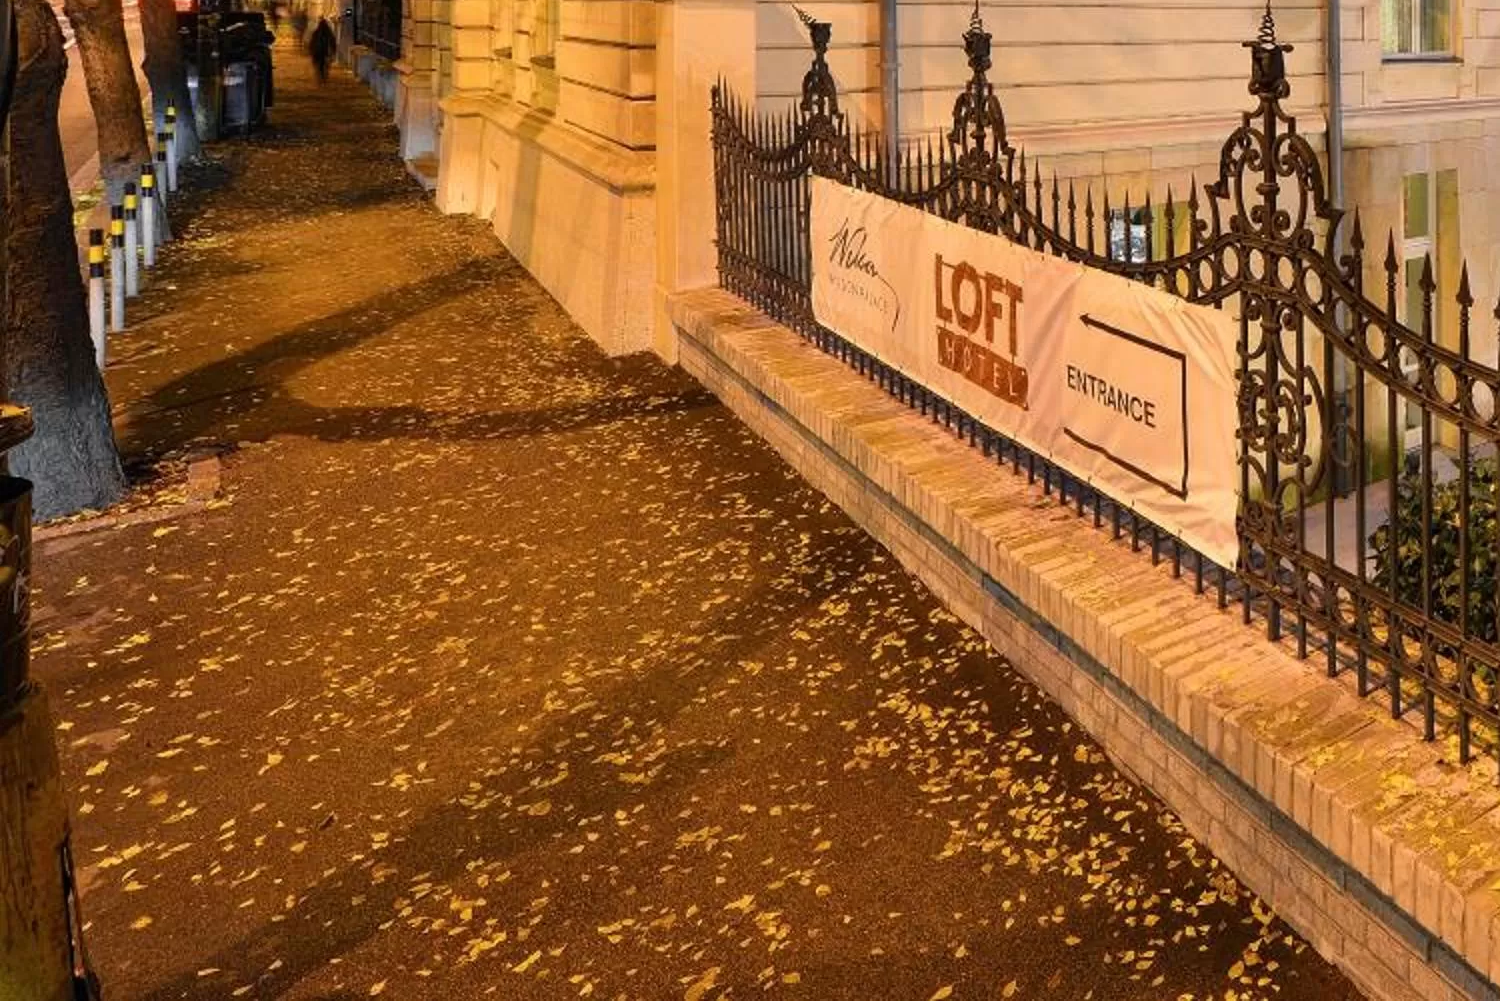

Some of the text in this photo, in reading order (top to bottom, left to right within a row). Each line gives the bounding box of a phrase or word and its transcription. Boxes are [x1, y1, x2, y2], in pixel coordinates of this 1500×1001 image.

[935, 253, 1024, 356] LOFT
[945, 338, 1018, 396] HOTEL
[1066, 364, 1156, 429] ENTRANCE
